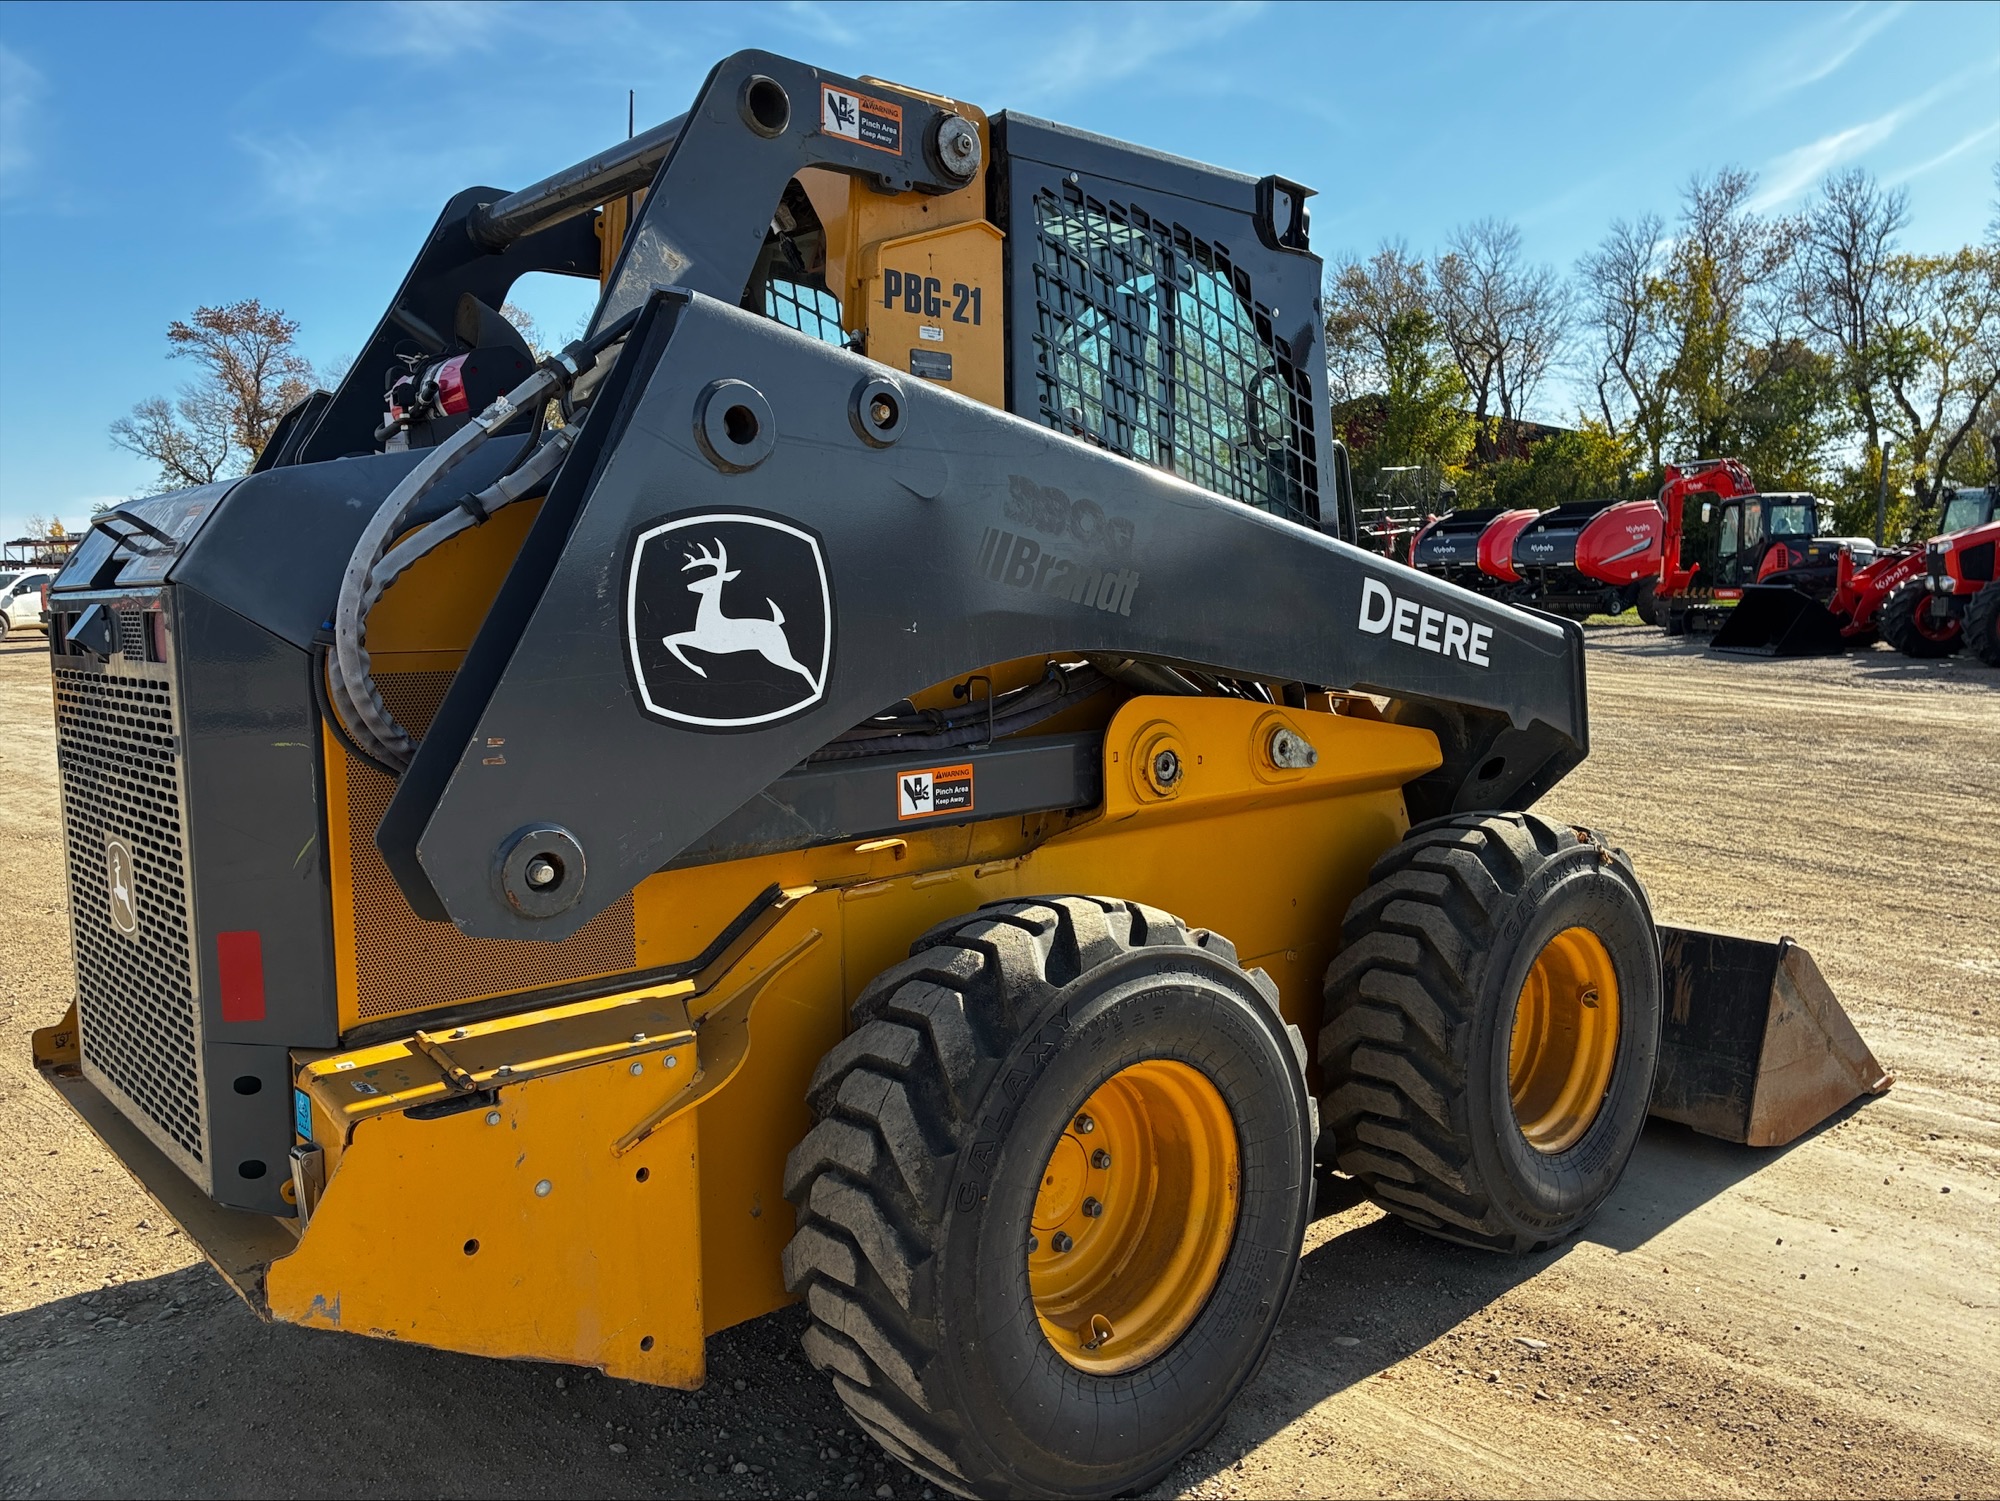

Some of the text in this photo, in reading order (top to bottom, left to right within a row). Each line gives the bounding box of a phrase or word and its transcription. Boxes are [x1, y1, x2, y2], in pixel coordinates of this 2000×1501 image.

[869, 101, 899, 117] WARNING
[861, 117, 898, 135] Pinch Area
[861, 128, 892, 144] Keep Away
[884, 268, 981, 326] PBG-21
[1626, 523, 1650, 533] Kubota
[1433, 546, 1456, 554] Kubota
[1531, 543, 1554, 552] Kubota
[1002, 535, 1140, 617] Brandt
[1874, 565, 1909, 590] Kubota
[1358, 576, 1494, 668] DEERE
[942, 769, 970, 779] WARNING
[935, 786, 969, 796] Pinch Area
[950, 796, 964, 804] Away
[1503, 855, 1582, 941] GALAXY
[1125, 989, 1172, 1008] RATING
[956, 1001, 1072, 1214] GALAXY
